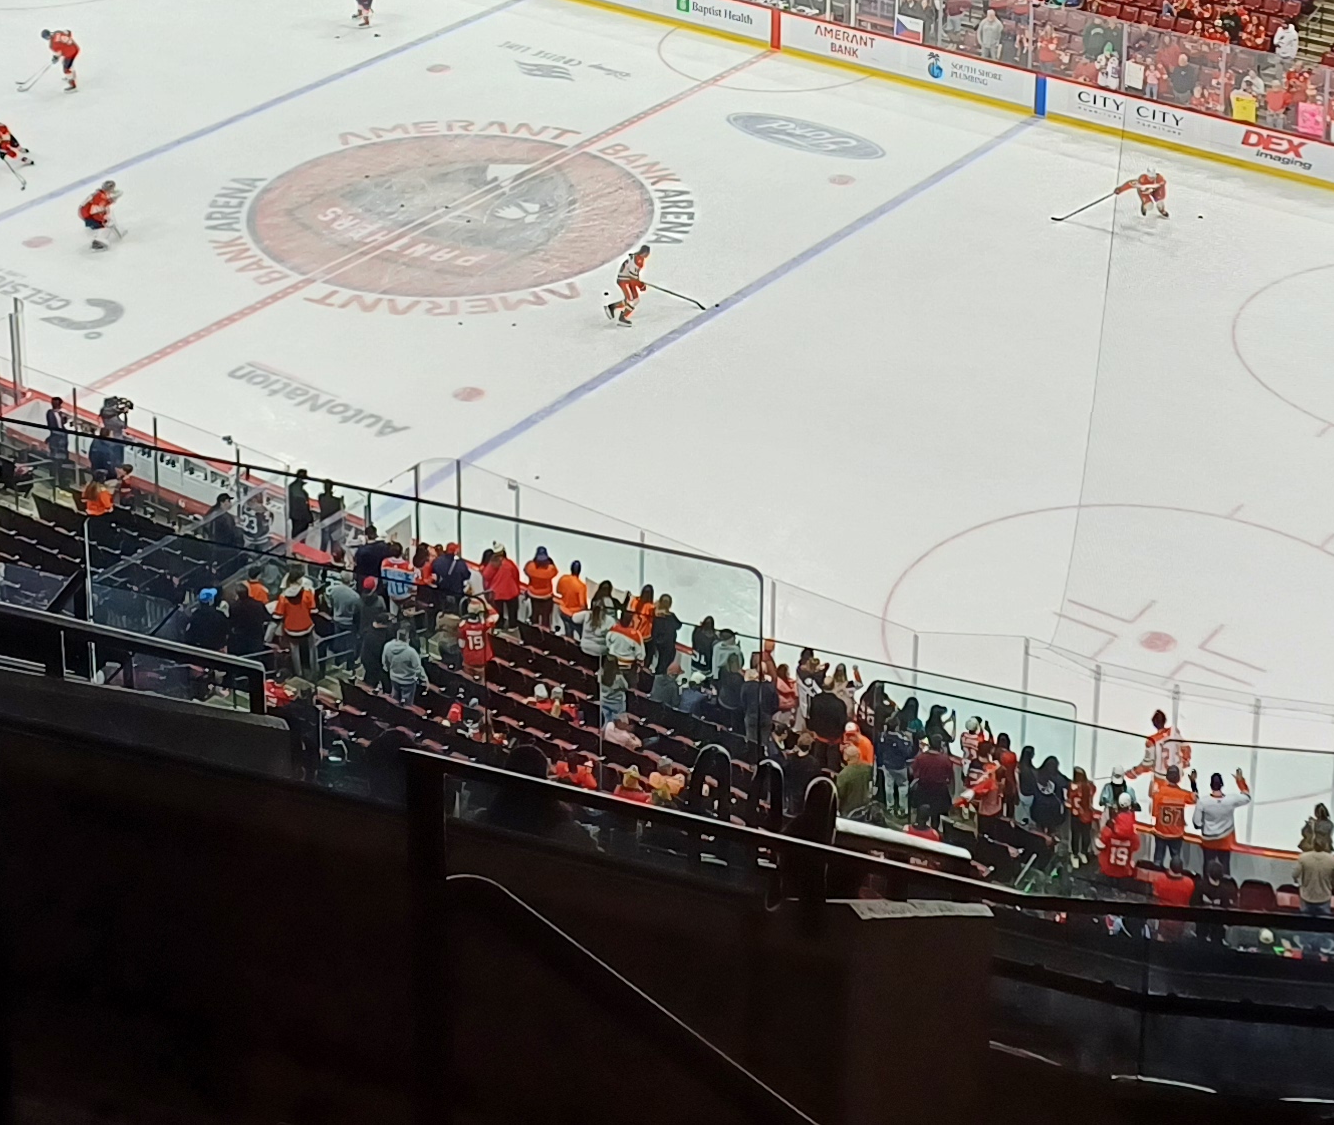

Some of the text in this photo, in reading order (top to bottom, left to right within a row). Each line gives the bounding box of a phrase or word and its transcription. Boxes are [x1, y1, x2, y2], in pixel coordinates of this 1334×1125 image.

[691, 1, 753, 25] Baptist Health
[814, 25, 876, 49] AMERANT
[830, 42, 859, 59] BANK
[950, 62, 1003, 81] SOUTH SHORE
[1078, 91, 1124, 111] CITY
[1137, 106, 1184, 127] CITY
[756, 120, 858, 151] Ford
[1241, 130, 1308, 159] DEX
[1255, 149, 1313, 171] imaging
[338, 119, 695, 245] AMERANT BANK ARENA
[204, 177, 584, 316] AMERANT BANK ARENA
[227, 364, 412, 438] AutoNation
[467, 636, 485, 650] 19
[1110, 846, 1130, 866] 19
